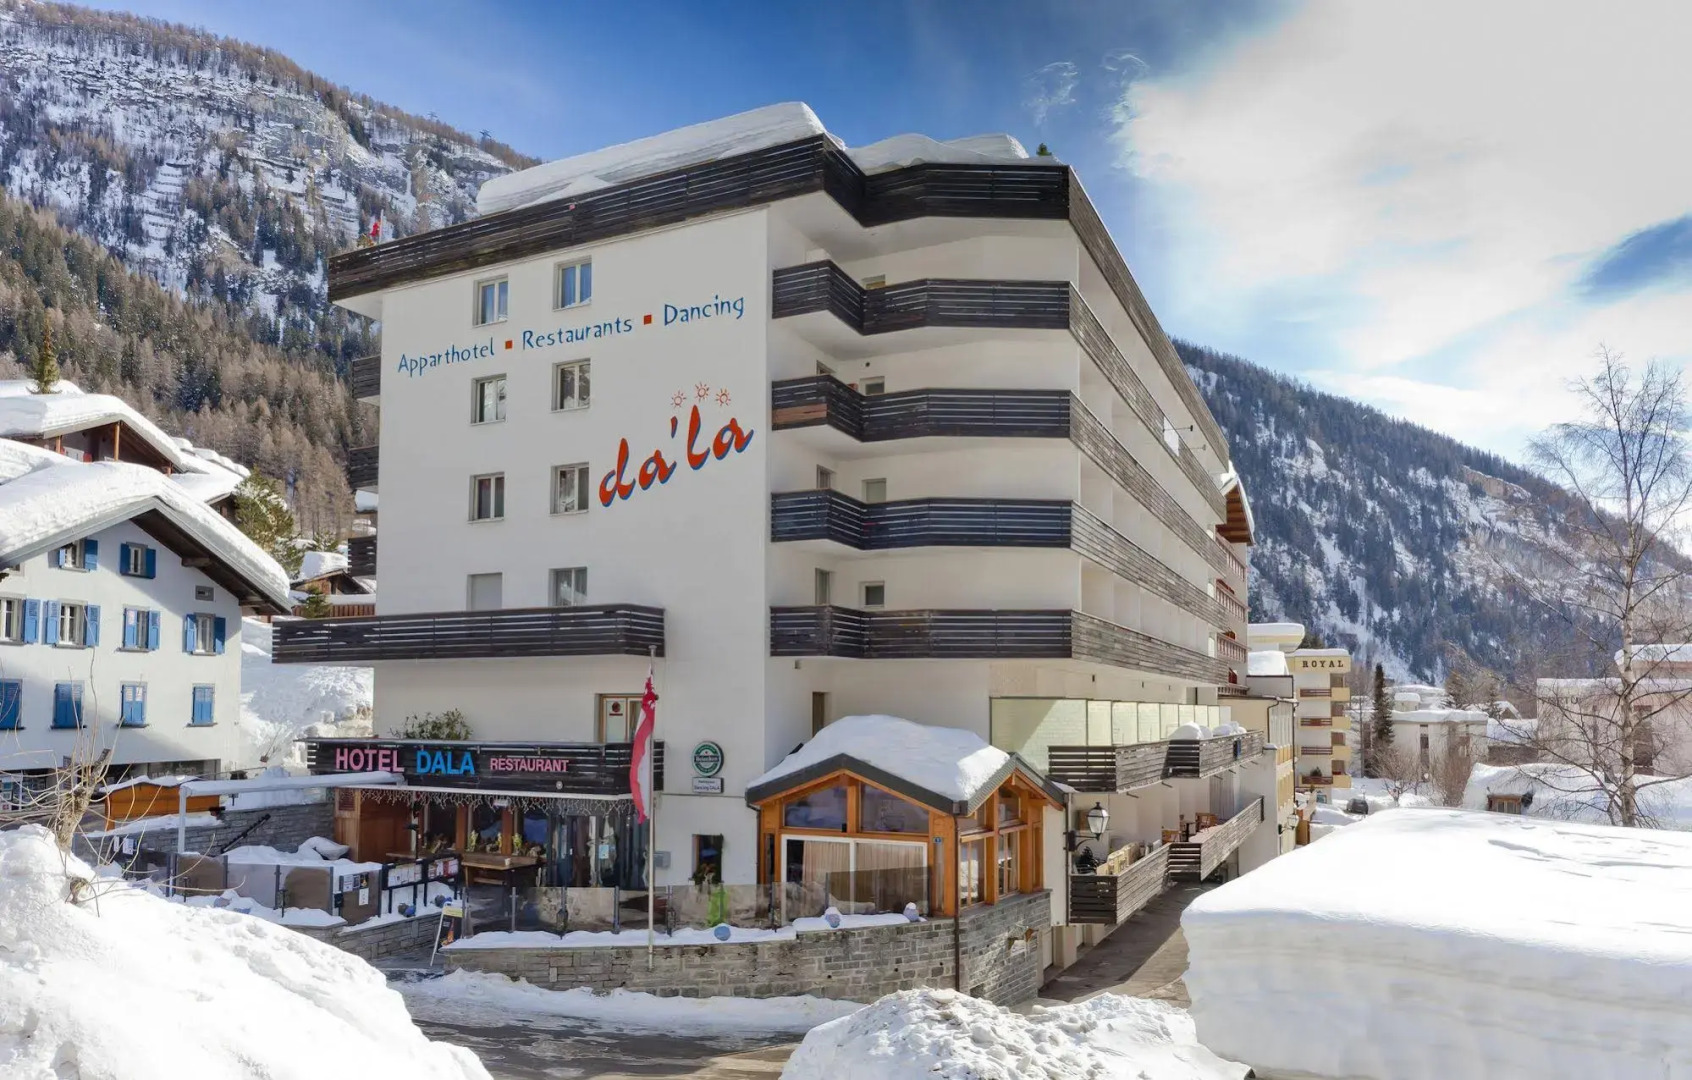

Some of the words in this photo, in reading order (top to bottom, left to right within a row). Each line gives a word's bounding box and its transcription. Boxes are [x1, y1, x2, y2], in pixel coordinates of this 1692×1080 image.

[397, 337, 496, 378] Apparthotel
[521, 316, 634, 350] Restaurants
[662, 295, 746, 327] Dancing
[1302, 660, 1344, 668] ROYAL
[335, 748, 405, 773] HOTEL
[416, 750, 476, 775] DALA
[490, 757, 569, 772] RESTAURANT
